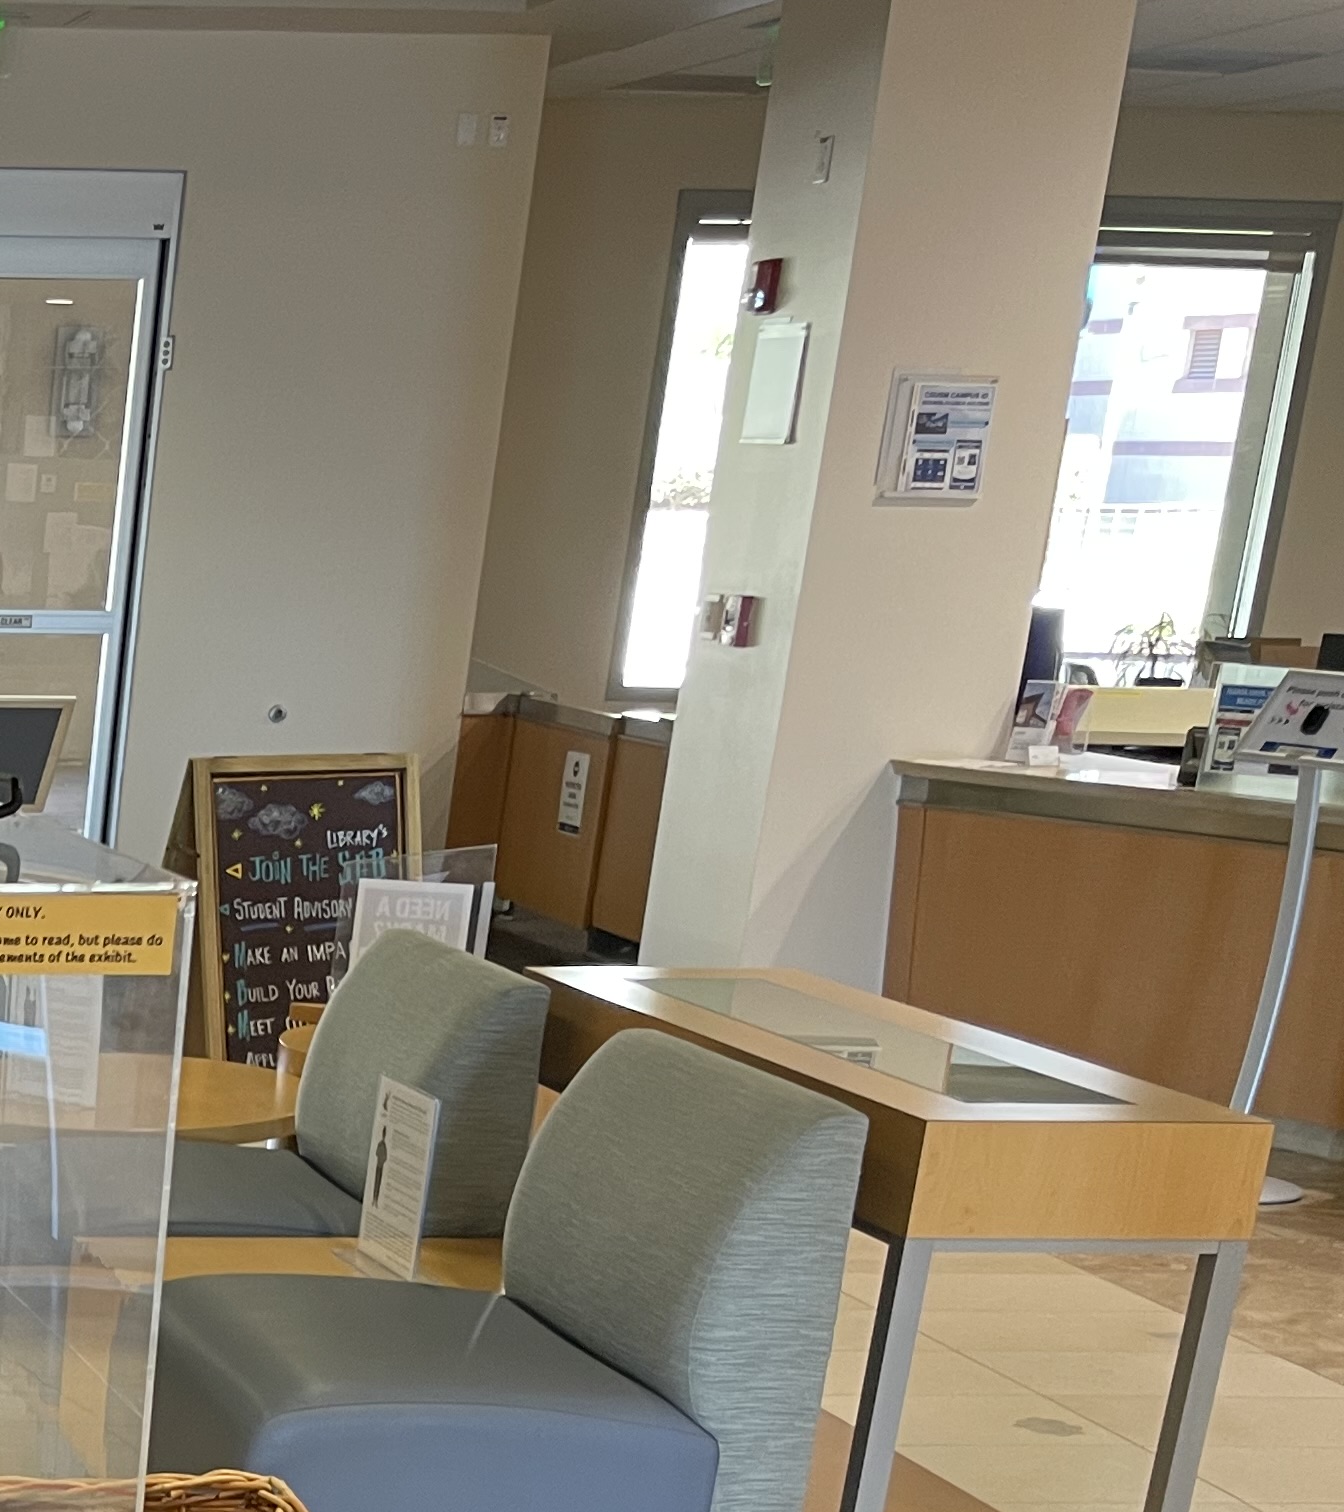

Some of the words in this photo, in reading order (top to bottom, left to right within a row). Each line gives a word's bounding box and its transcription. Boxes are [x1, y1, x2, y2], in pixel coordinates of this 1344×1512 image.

[299, 853, 329, 882] THE
[6, 906, 46, 919] ONLY.
[233, 897, 287, 920] STUDENT
[294, 896, 353, 920] ADVISORY
[25, 935, 38, 946] to
[42, 934, 74, 948] read,
[78, 934, 100, 946] but
[103, 934, 143, 948] please
[147, 934, 163, 946] do
[48, 950, 63, 963] of
[65, 951, 85, 963] the
[89, 950, 137, 963] exhibit.
[234, 941, 271, 970] MAKE
[281, 947, 298, 963] AN
[307, 941, 346, 963] IMPA
[237, 979, 278, 1006] BUILD
[286, 979, 320, 1000] YOUR
[238, 1009, 275, 1041] MEET
